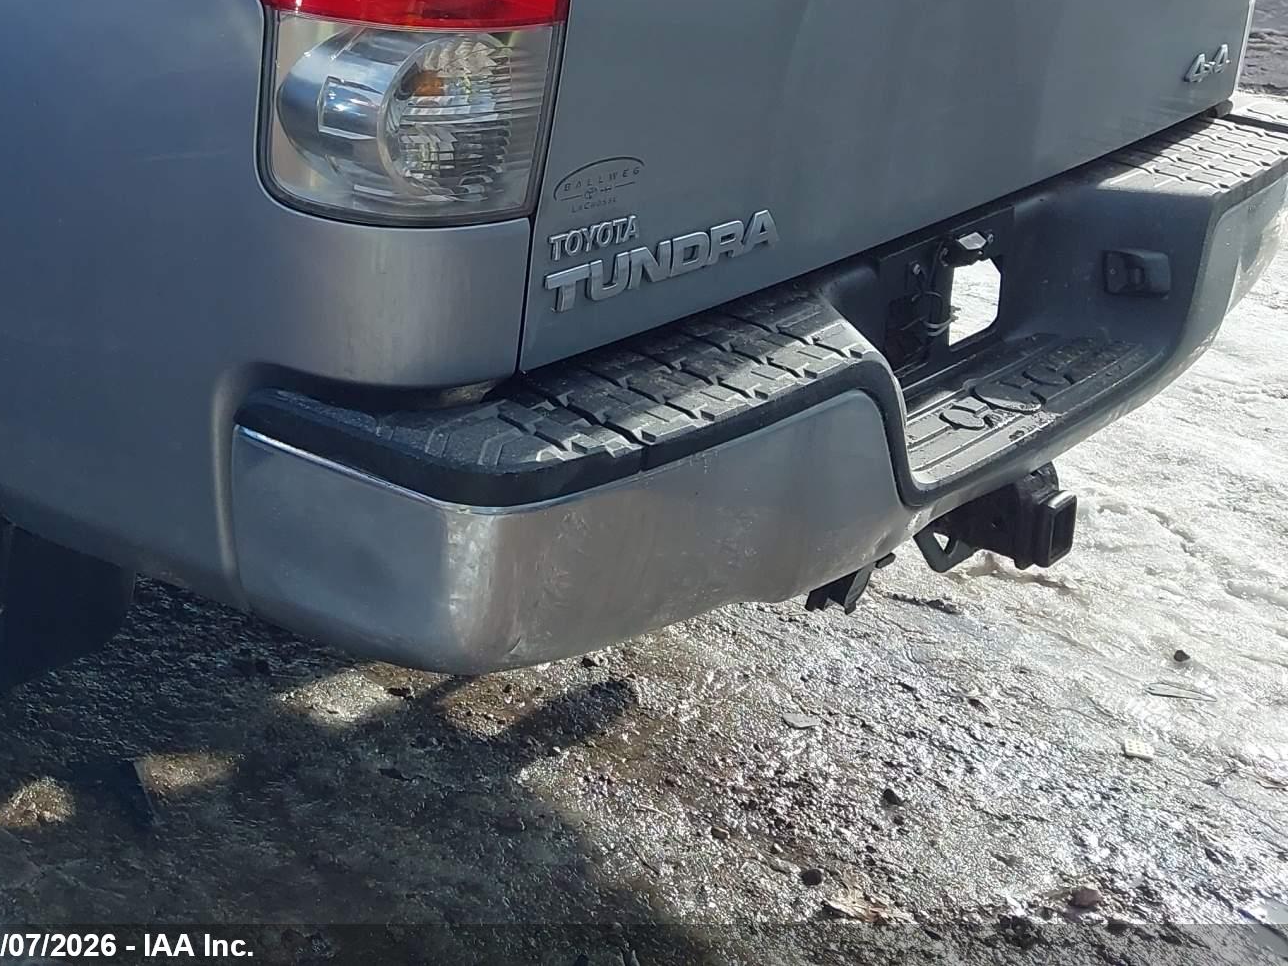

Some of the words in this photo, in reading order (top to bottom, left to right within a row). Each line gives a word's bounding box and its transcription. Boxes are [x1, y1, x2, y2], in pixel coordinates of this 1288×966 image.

[563, 166, 641, 192] BALLWEG
[544, 209, 781, 313] TUNDRA
[549, 215, 640, 261] TOYOTA
